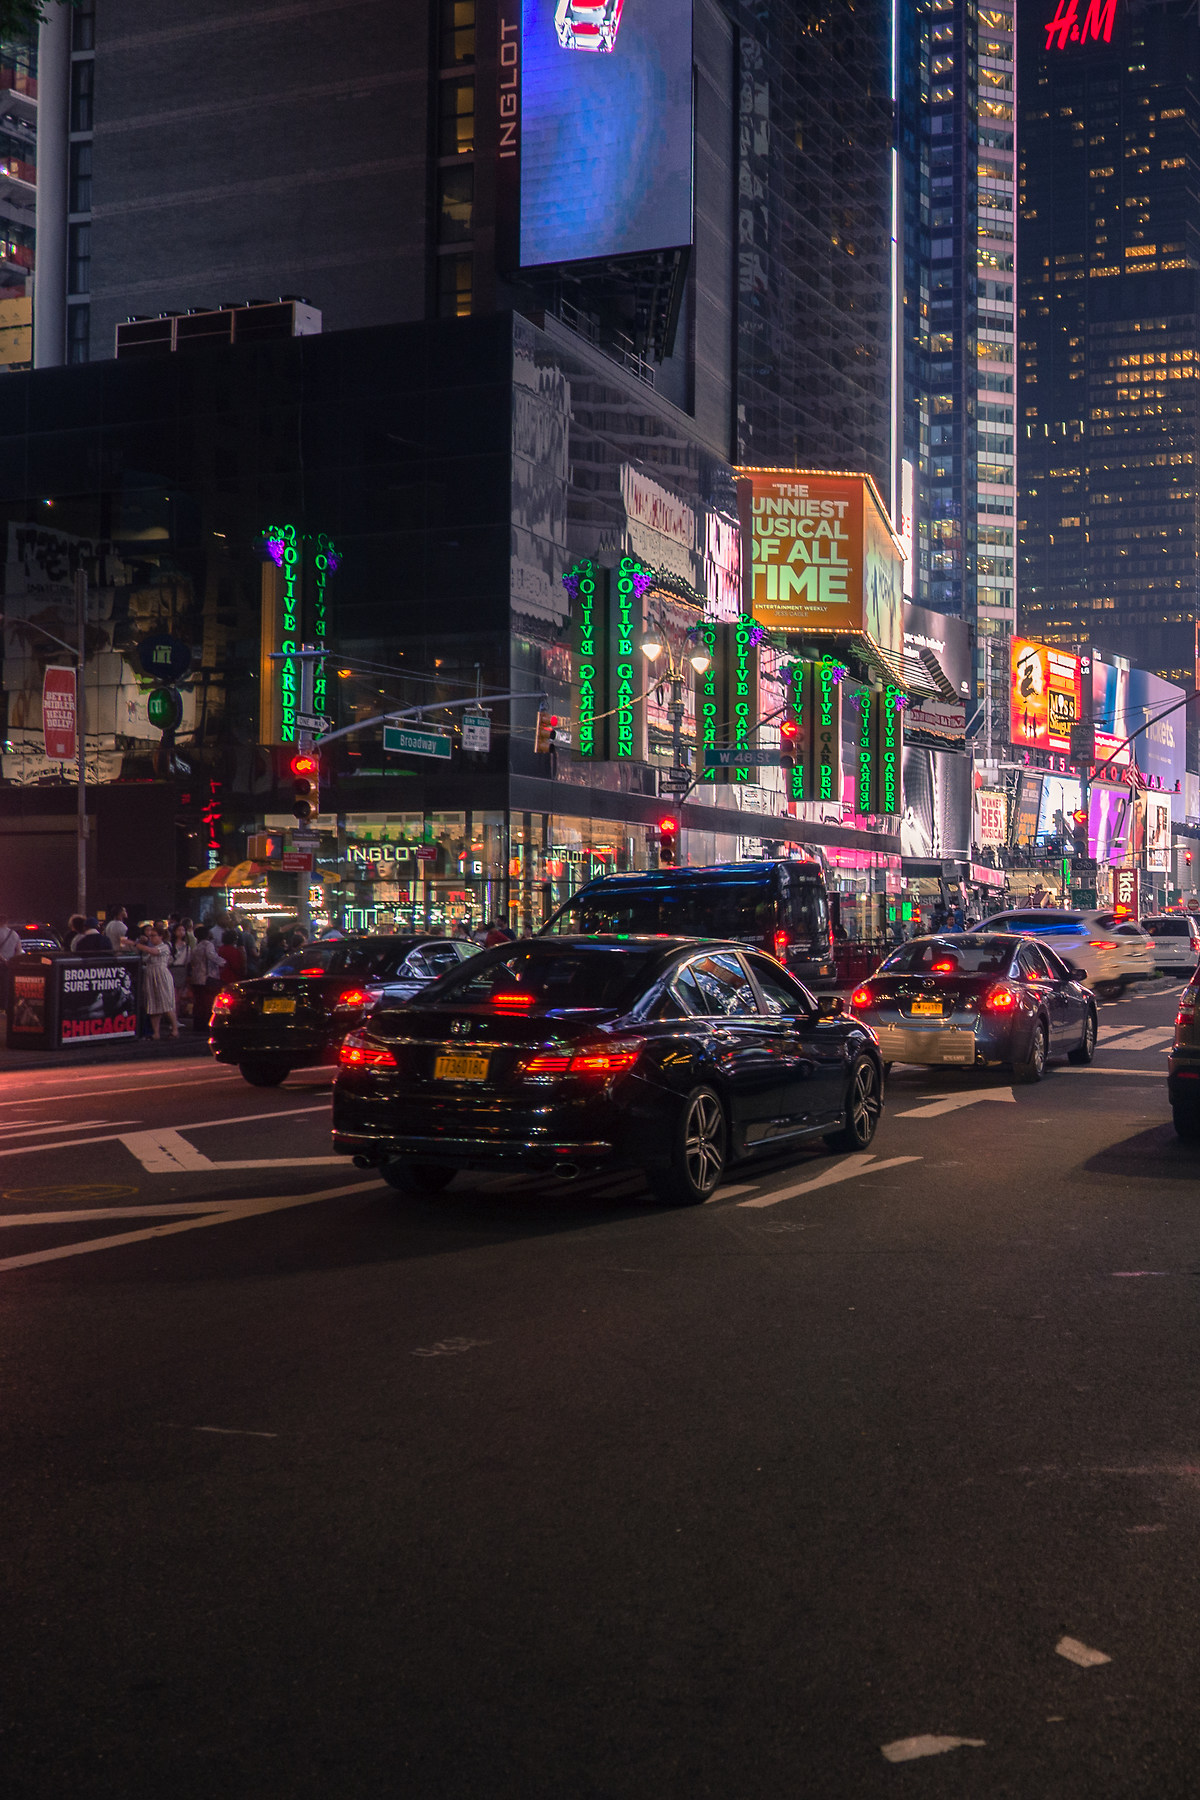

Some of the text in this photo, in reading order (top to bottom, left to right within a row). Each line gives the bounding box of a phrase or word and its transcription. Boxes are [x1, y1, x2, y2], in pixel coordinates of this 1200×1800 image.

[1044, 0, 1118, 50] H&M
[500, 18, 518, 158] INGLOT
[752, 497, 849, 519] UNNIEST
[752, 517, 849, 540] USICAL
[787, 540, 849, 565] ALL
[284, 546, 298, 632] OLIVE
[617, 577, 633, 656] OLIVE
[736, 631, 749, 696] OLIVE
[281, 639, 296, 742] GARDEN
[820, 669, 832, 726] OLIVE
[299, 716, 326, 729] ONE WAY
[617, 663, 633, 757] GARDEN
[884, 699, 895, 748] OLIVE
[400, 734, 437, 755] Broadway
[719, 752, 770, 762] W 48 St
[884, 752, 896, 812] GARDEN
[981, 808, 1003, 829] BEST
[346, 846, 419, 862] INGLOT
[1119, 871, 1135, 903] tkts
[63, 978, 122, 993] SURE THING
[64, 967, 126, 981] BROADWAY'S
[62, 1013, 137, 1038] CHICAGO
